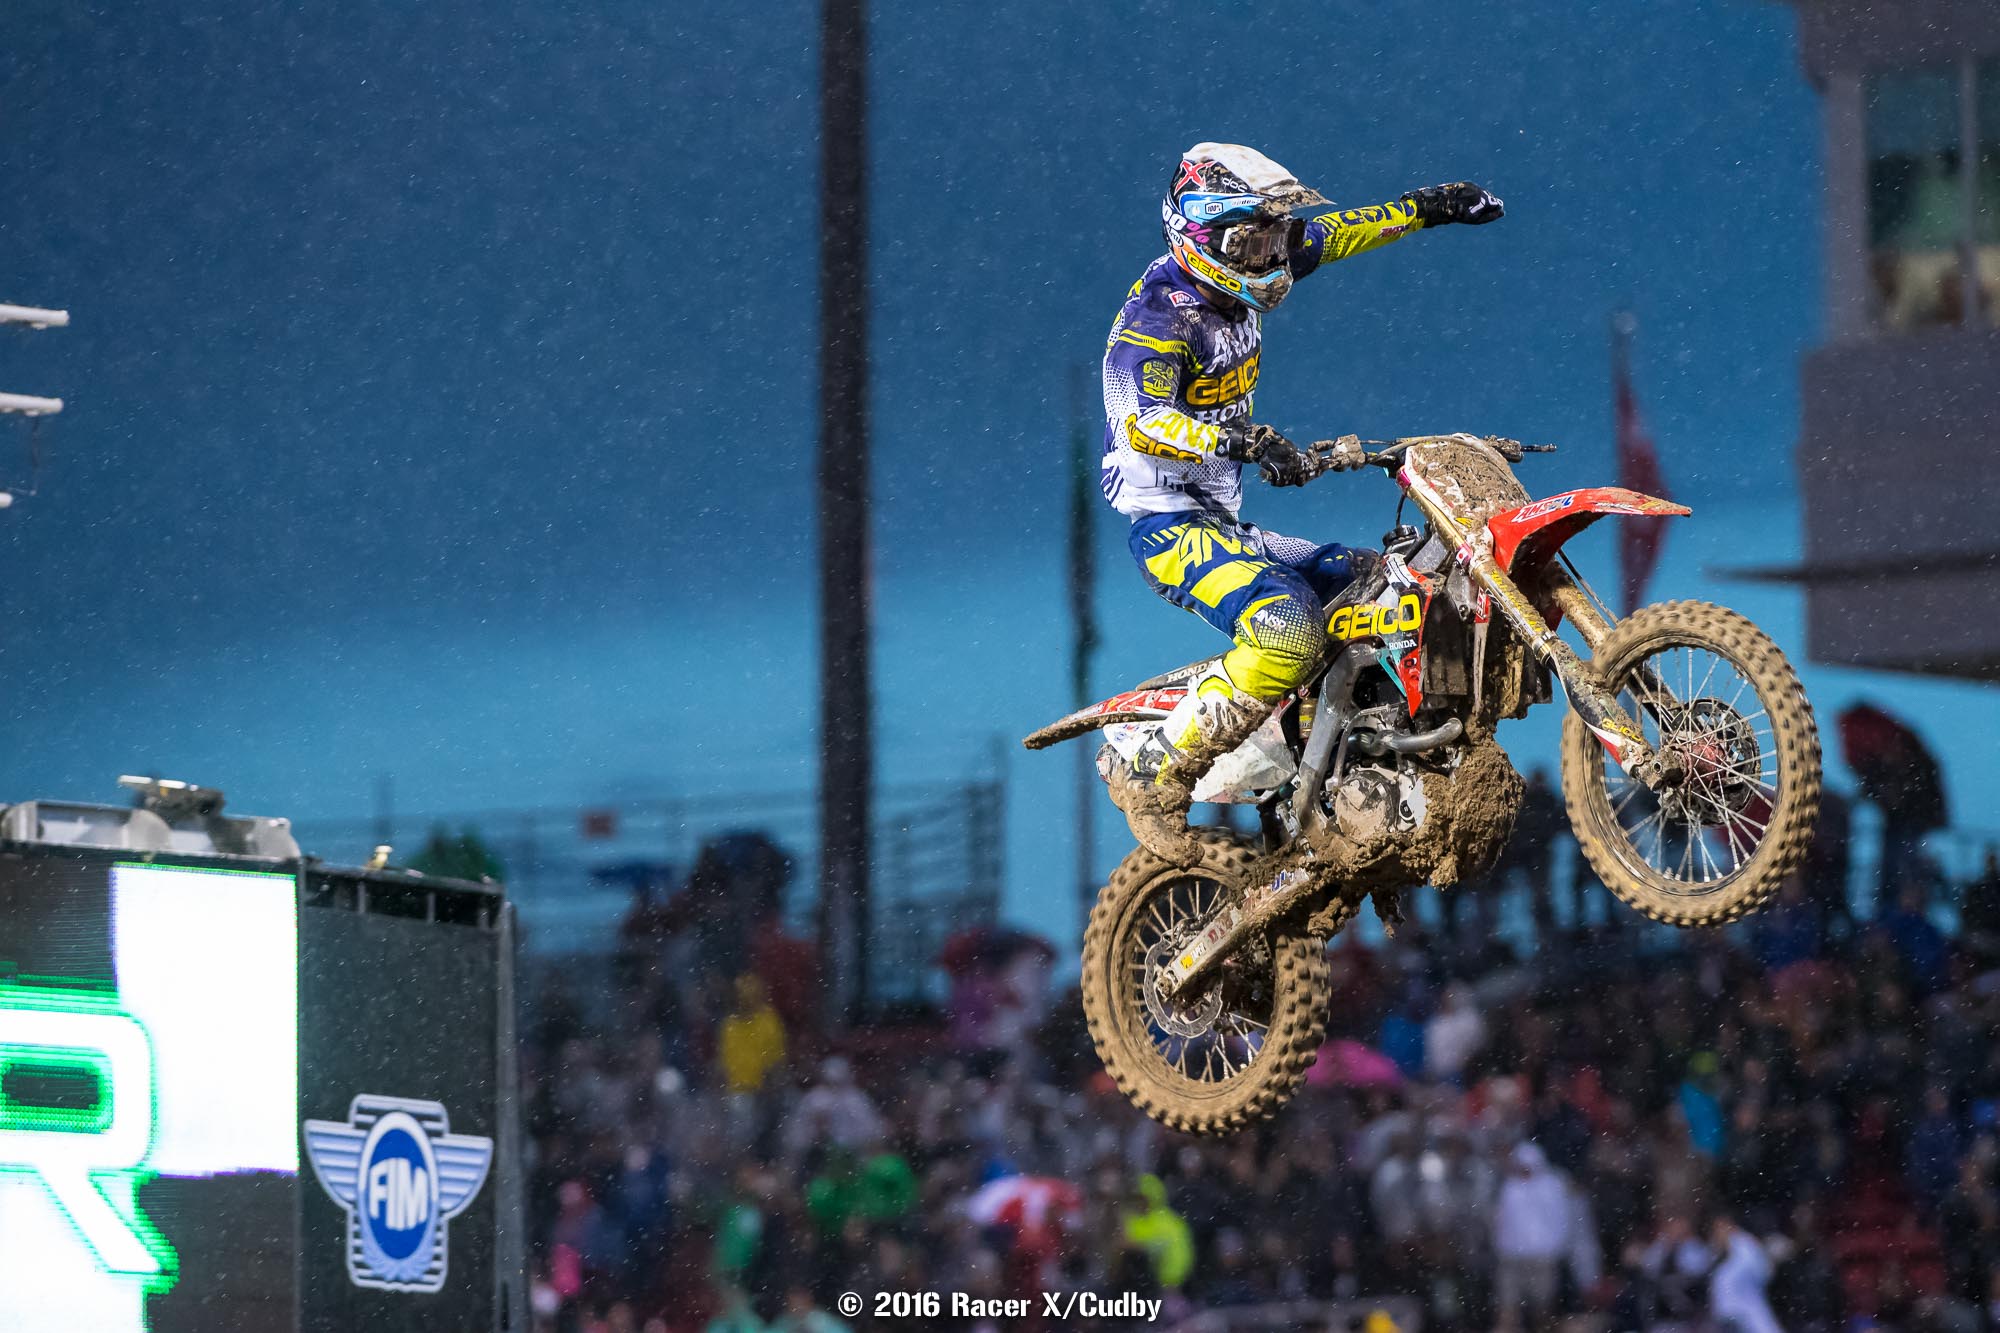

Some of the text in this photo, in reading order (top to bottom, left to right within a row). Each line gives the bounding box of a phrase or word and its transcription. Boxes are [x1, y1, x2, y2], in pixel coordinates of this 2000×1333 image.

[1187, 252, 1242, 292] GEICO
[1327, 594, 1422, 641] GEICO
[1389, 639, 1417, 650] HONDA
